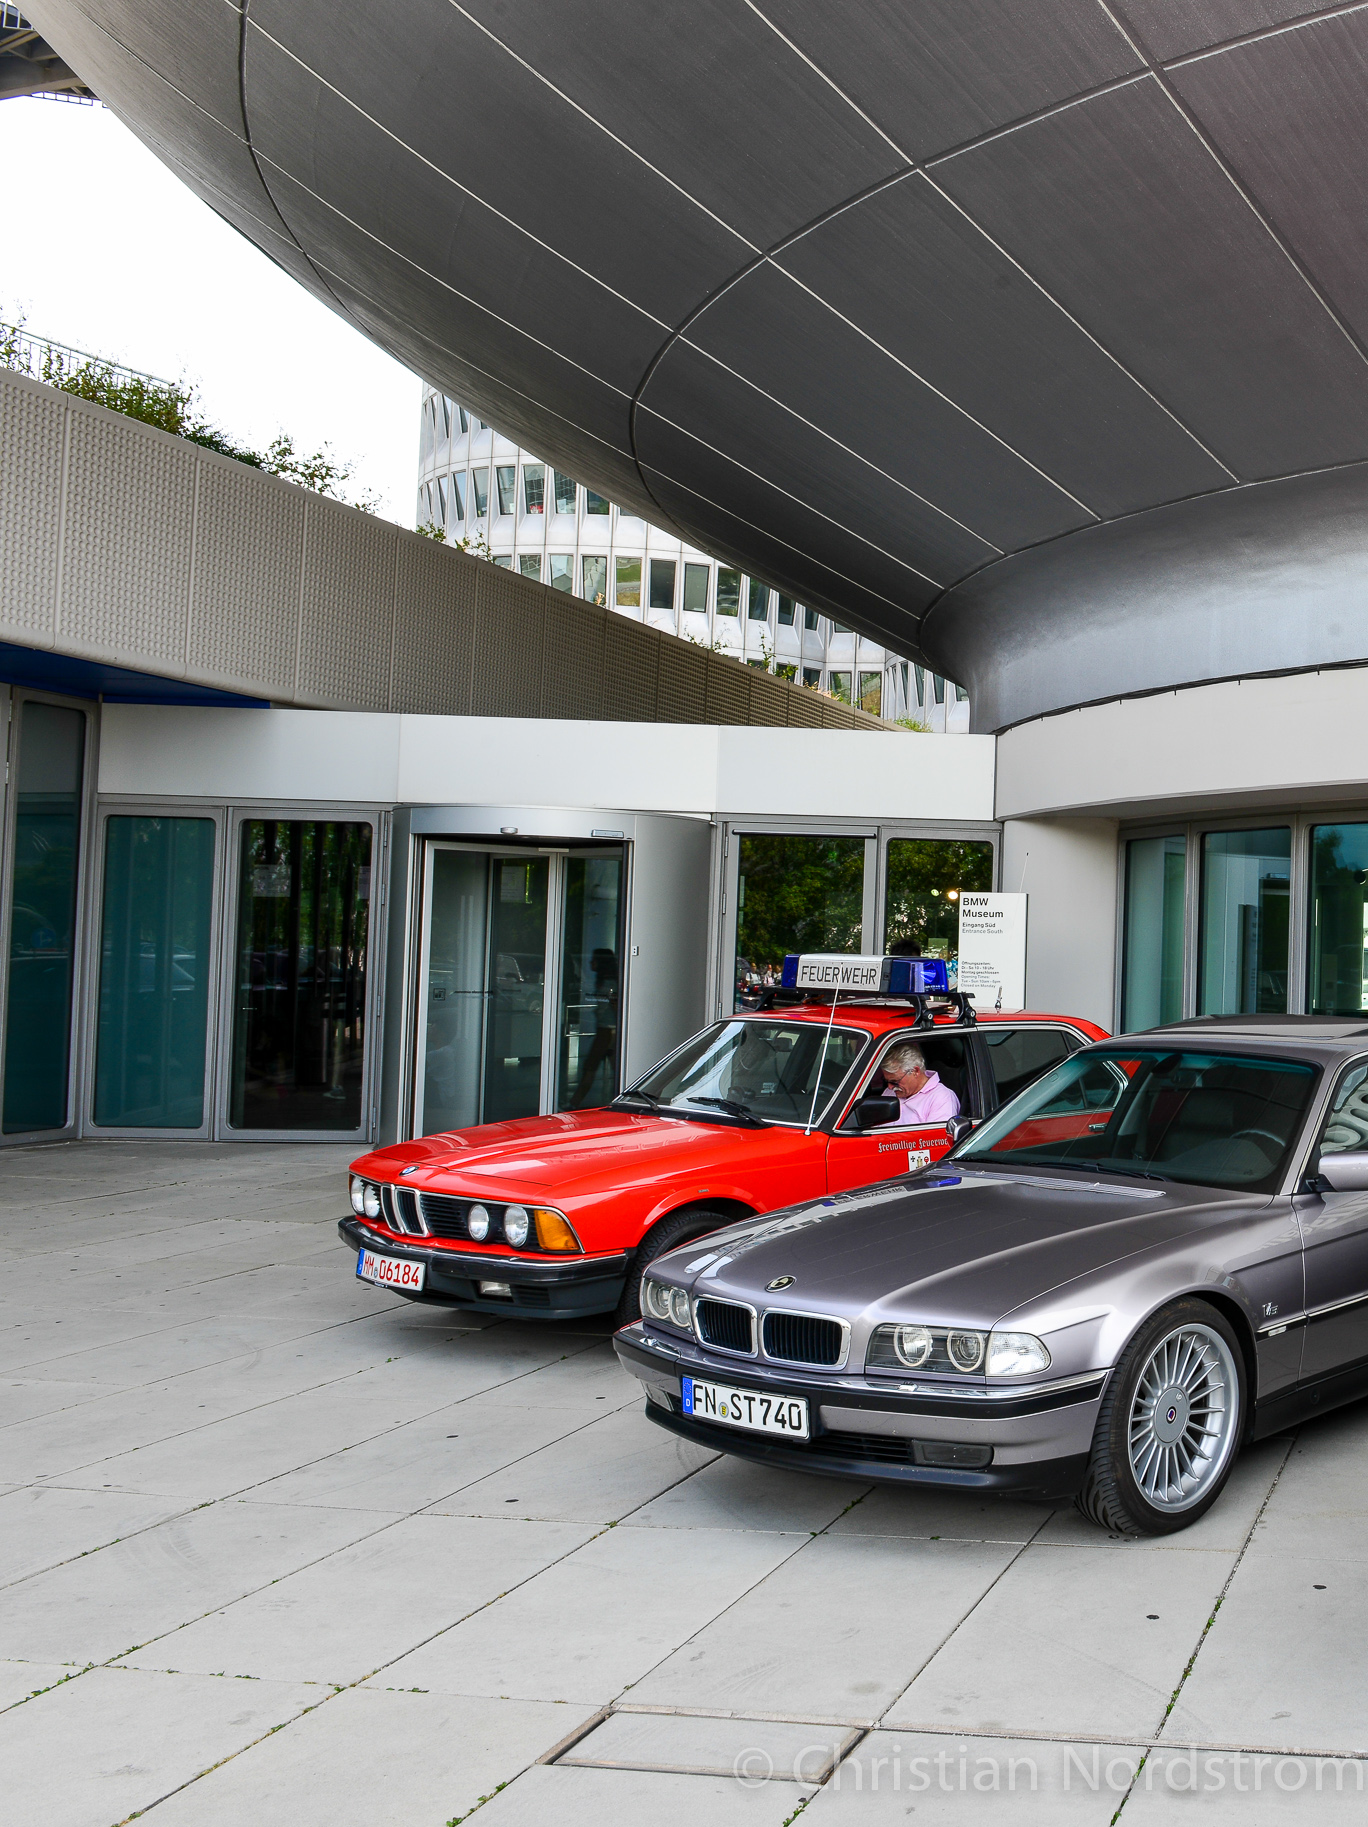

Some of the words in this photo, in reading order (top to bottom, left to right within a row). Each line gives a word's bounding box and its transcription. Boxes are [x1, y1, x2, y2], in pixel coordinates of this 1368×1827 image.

[962, 897, 989, 906] BMW
[962, 909, 1004, 918] Museum
[800, 965, 877, 986] FEUERWEHR
[878, 1140, 917, 1153] Freiwillige
[918, 1138, 949, 1149] Feuerwe
[379, 1260, 420, 1287] 06184
[693, 1384, 717, 1415] FN
